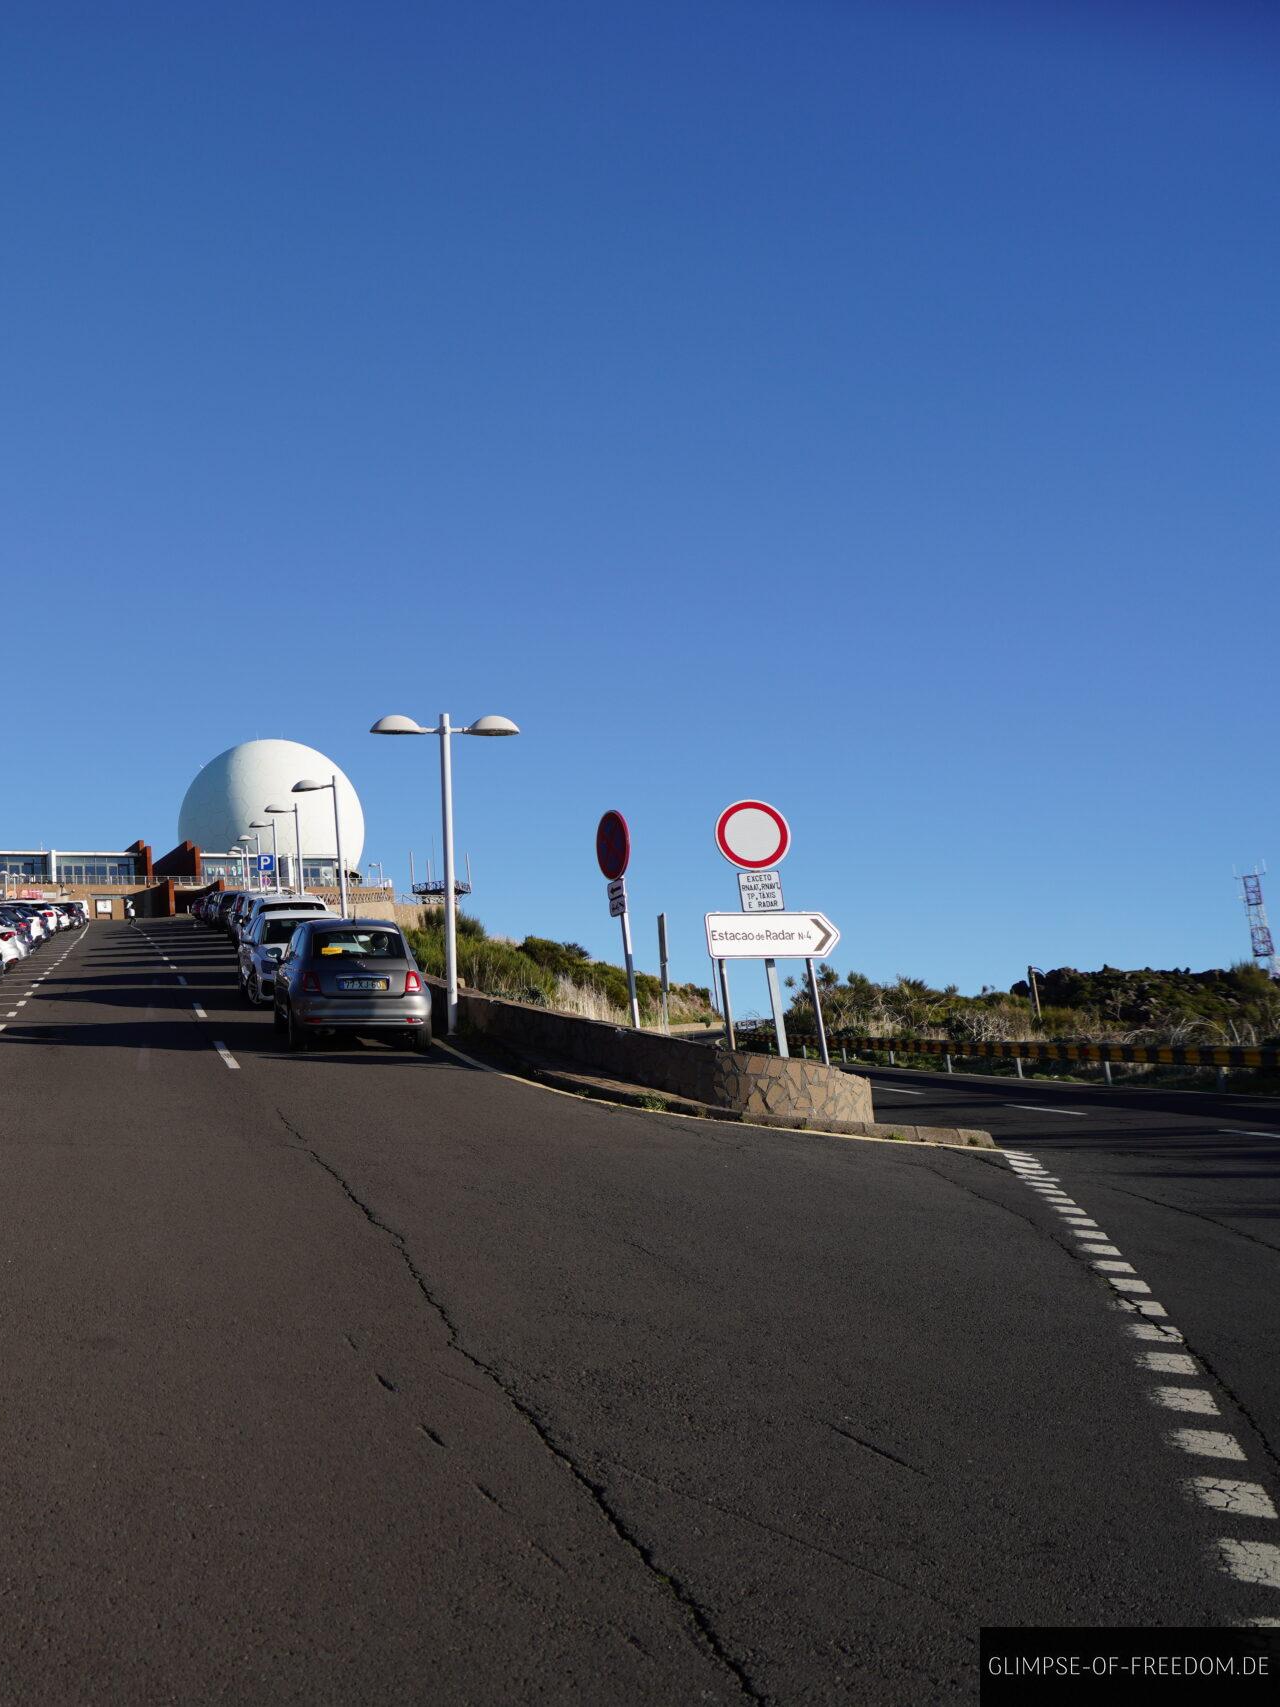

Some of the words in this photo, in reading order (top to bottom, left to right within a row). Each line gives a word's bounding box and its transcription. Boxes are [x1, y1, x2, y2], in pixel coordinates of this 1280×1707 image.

[260, 856, 271, 869] P
[746, 874, 772, 882] EXCETO
[758, 900, 778, 908] RADAR
[711, 930, 754, 940] Estacao
[755, 931, 765, 940] de
[765, 930, 795, 940] Radar
